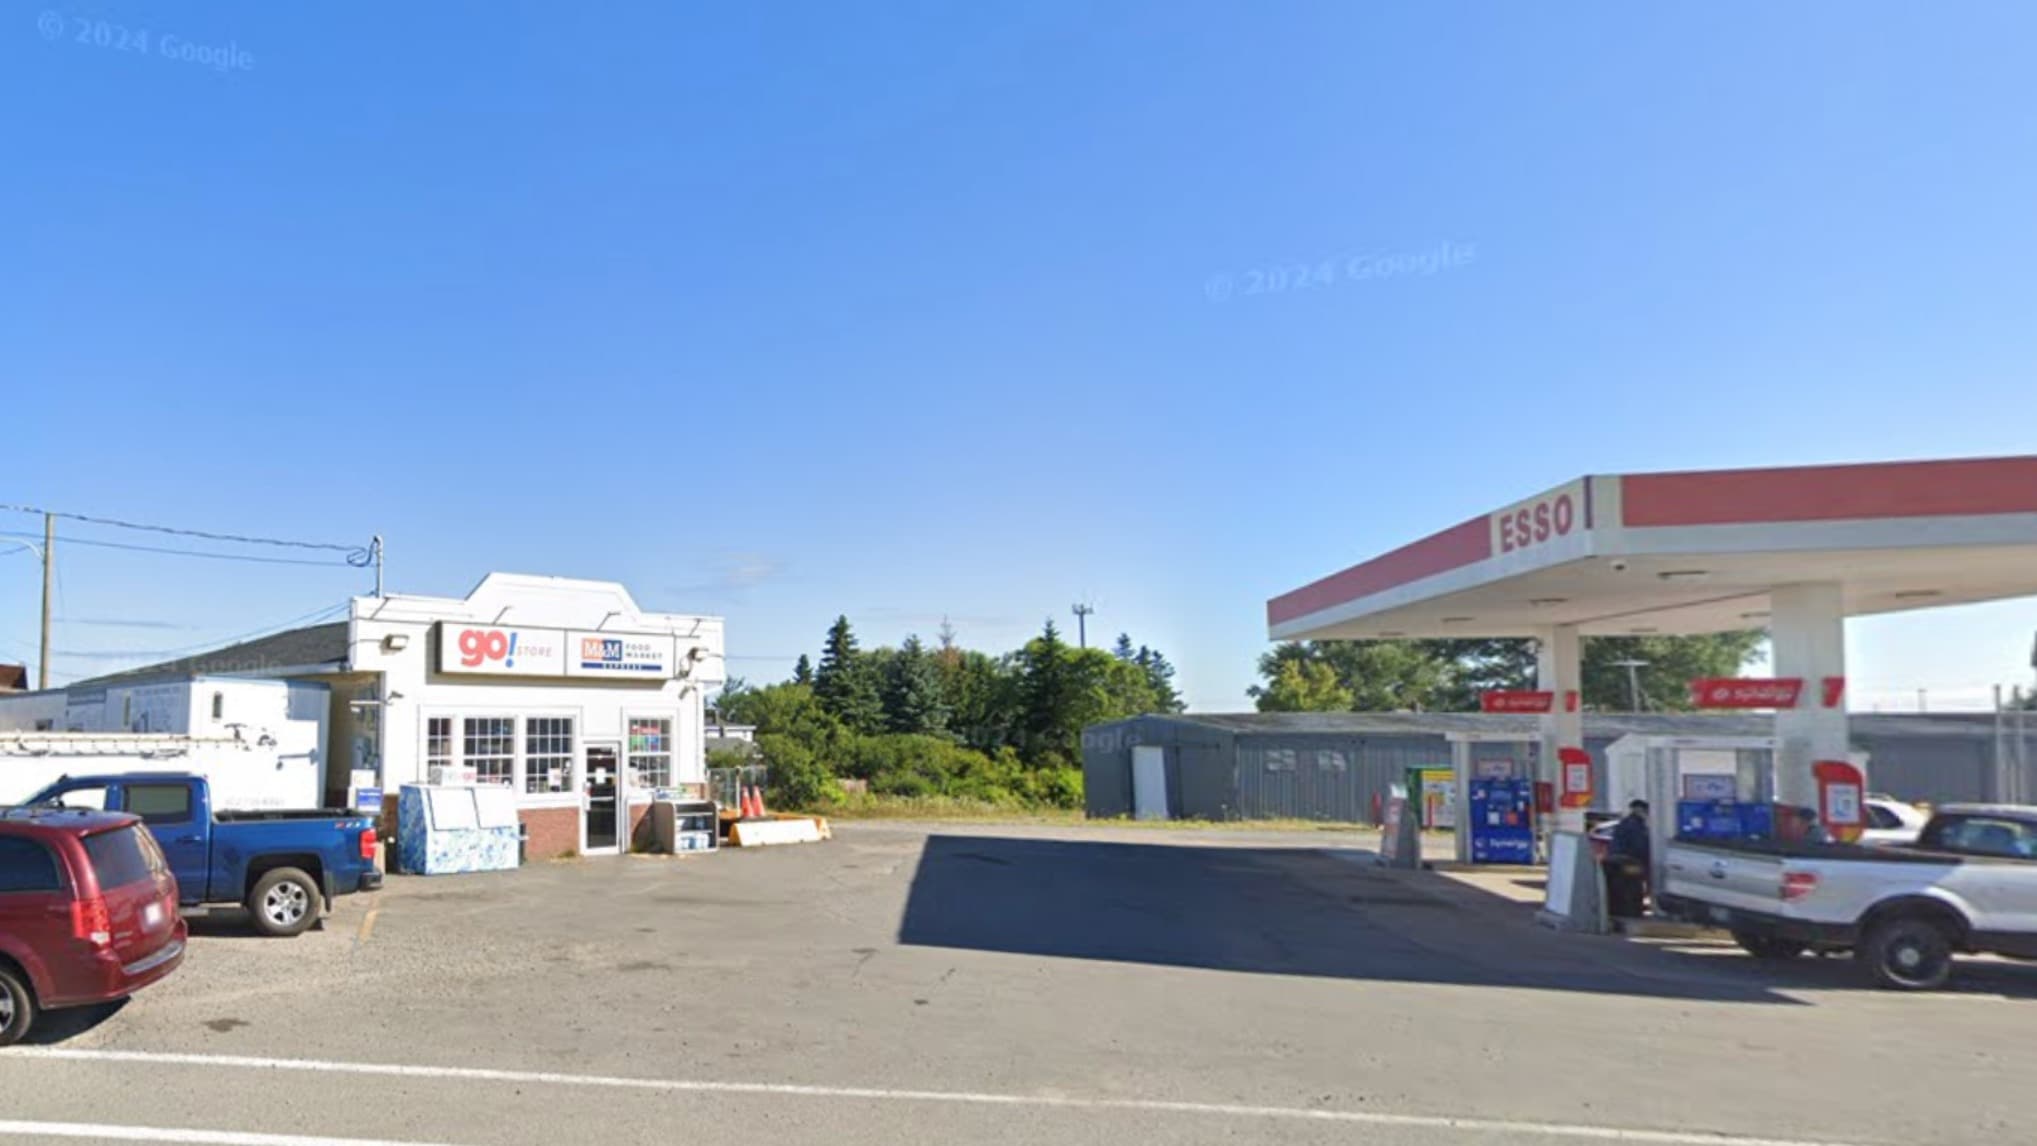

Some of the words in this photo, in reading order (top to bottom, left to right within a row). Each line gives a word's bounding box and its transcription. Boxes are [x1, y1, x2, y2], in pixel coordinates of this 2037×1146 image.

[1500, 493, 1573, 554] ESSO
[458, 628, 518, 668] go!
[517, 644, 553, 658] STORE
